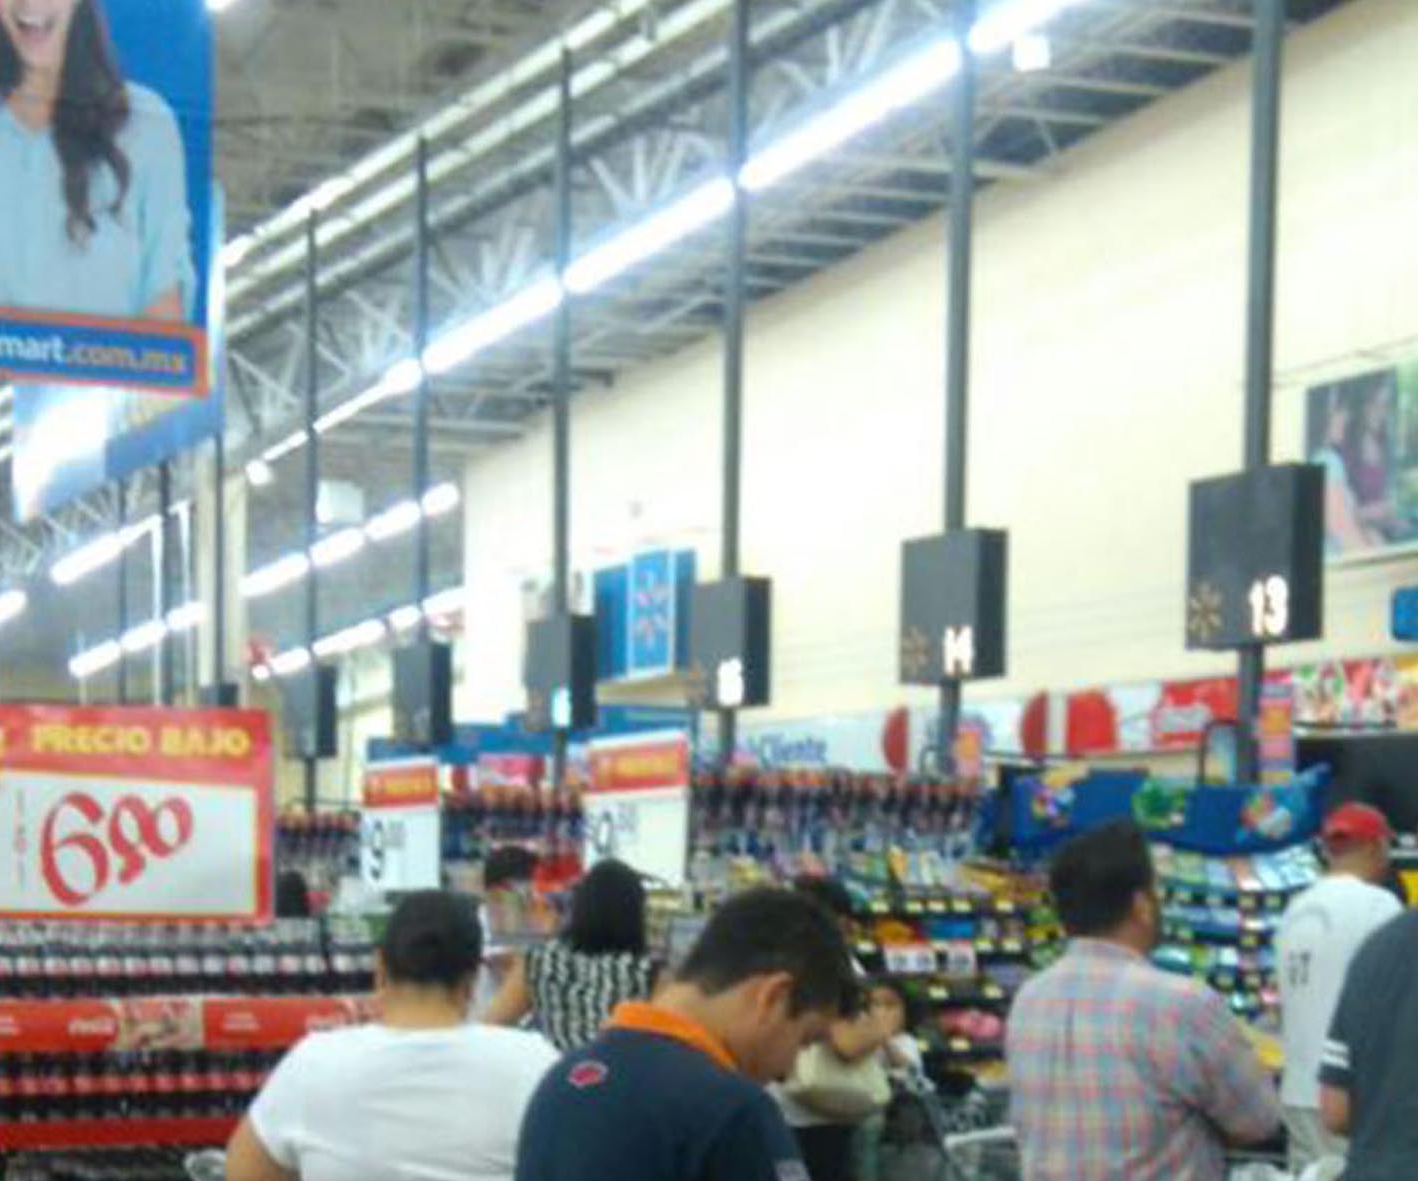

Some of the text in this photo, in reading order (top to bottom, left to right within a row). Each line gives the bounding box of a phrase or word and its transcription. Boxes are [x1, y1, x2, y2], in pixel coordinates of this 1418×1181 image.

[1248, 574, 1288, 635] 13
[33, 723, 251, 757] PRECIO BAJO
